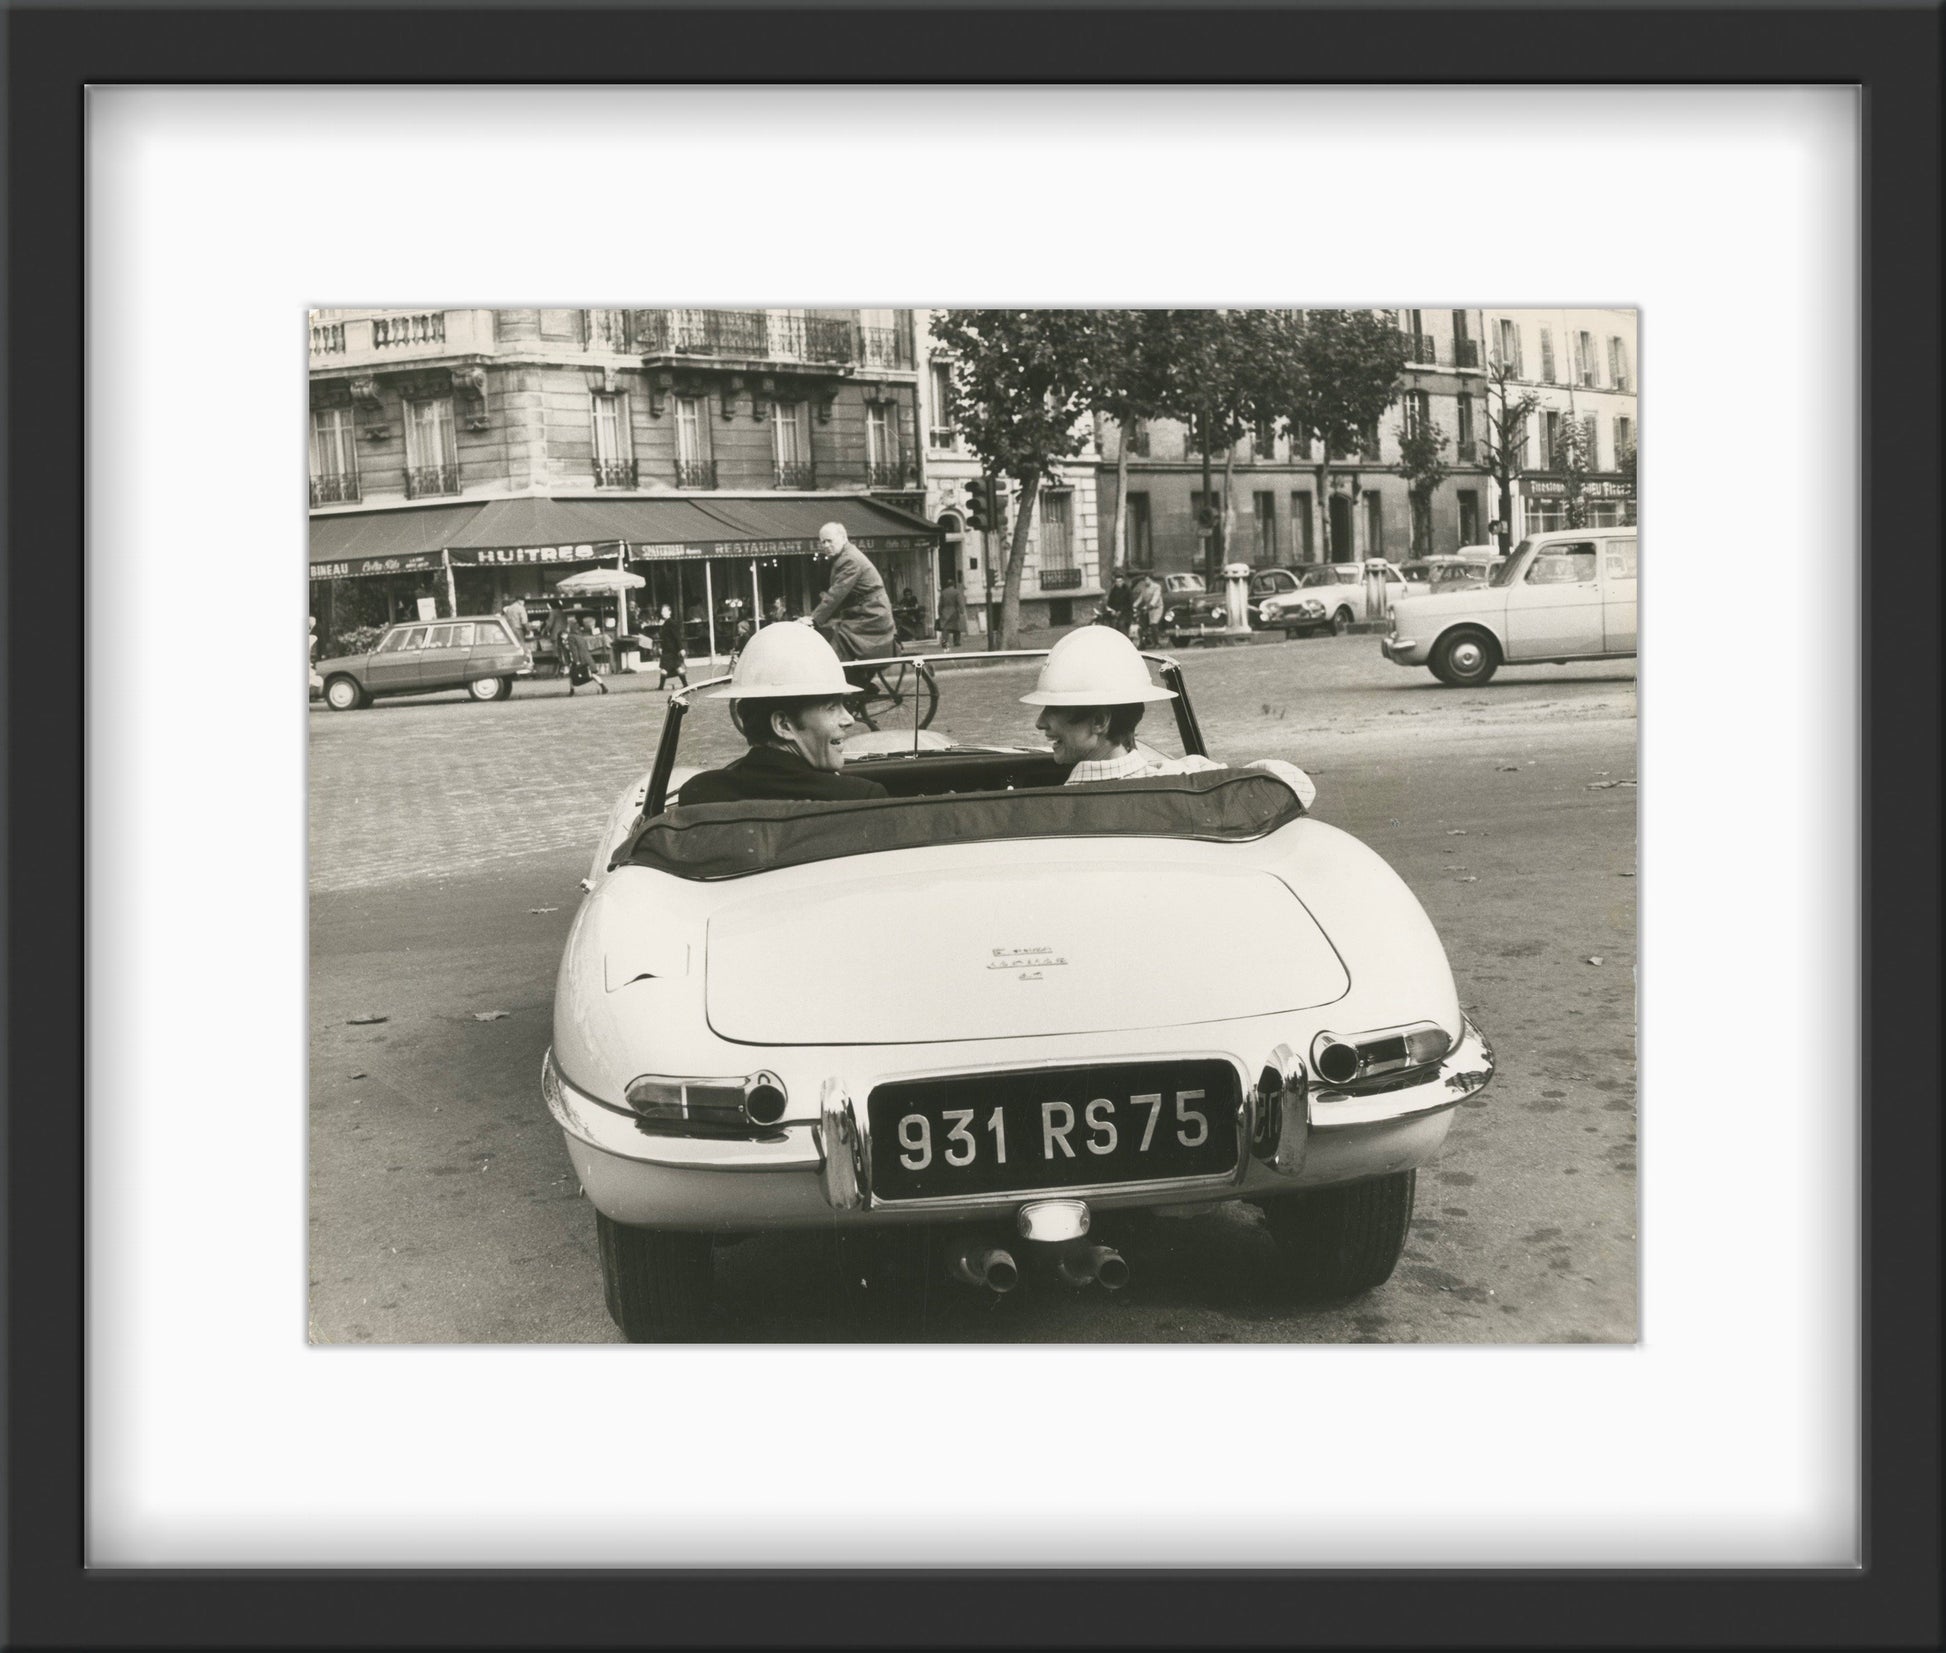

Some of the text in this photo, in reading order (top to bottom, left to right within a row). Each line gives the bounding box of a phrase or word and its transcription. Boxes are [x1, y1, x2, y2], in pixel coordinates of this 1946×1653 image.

[714, 540, 802, 554] RESTAURANT
[310, 562, 349, 577] BINEAU
[898, 1106, 1006, 1172] 931
